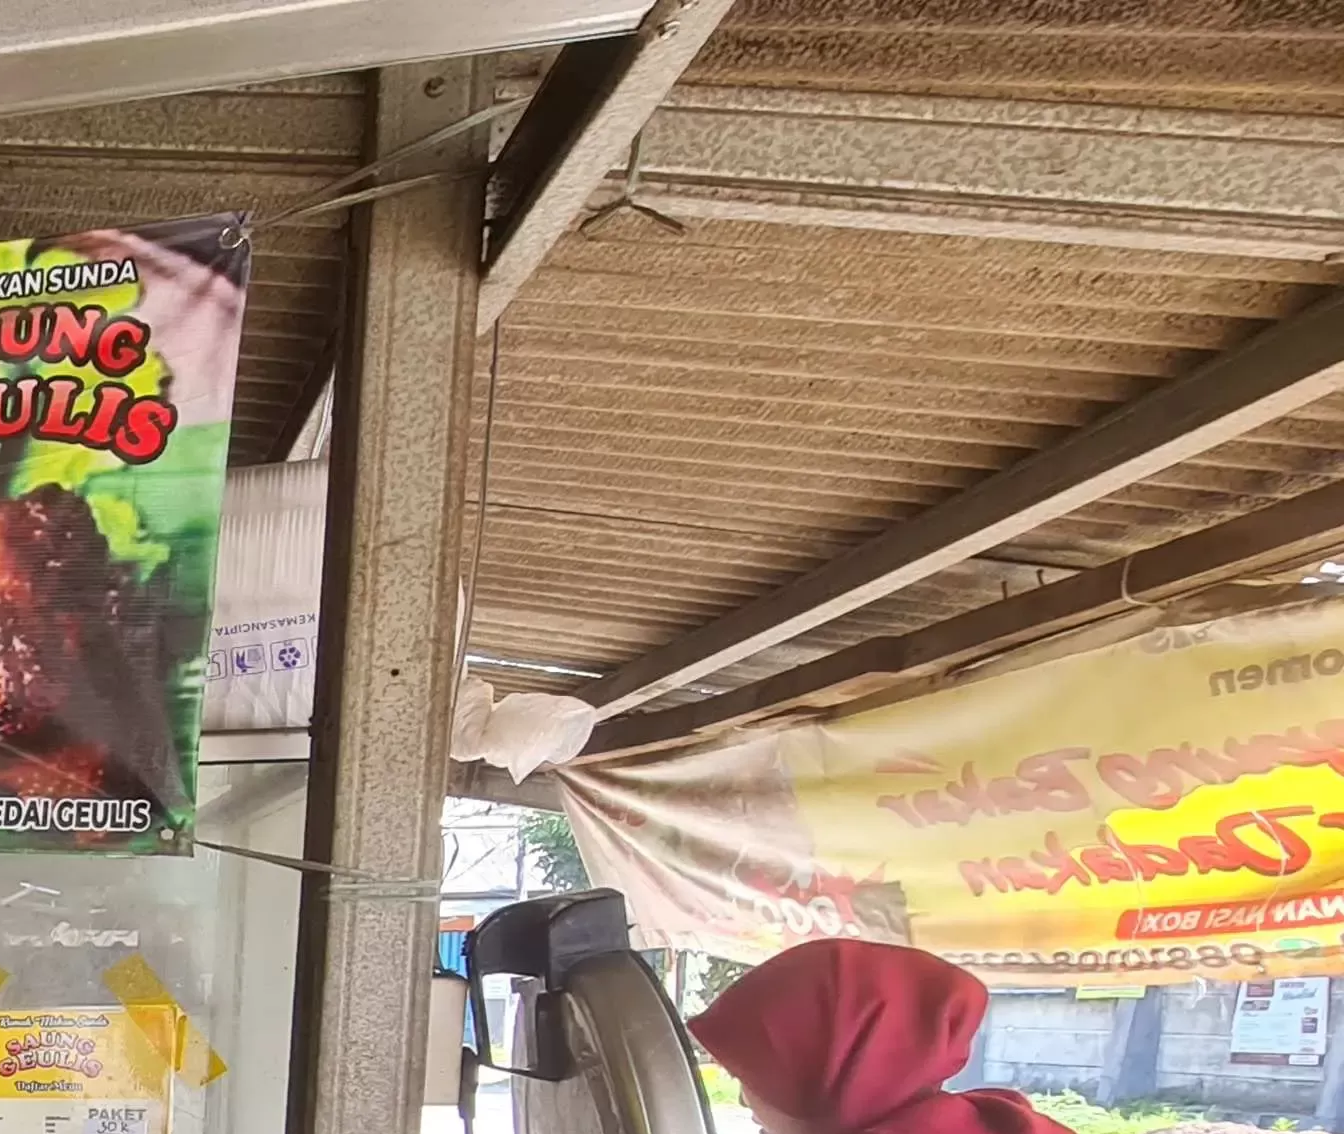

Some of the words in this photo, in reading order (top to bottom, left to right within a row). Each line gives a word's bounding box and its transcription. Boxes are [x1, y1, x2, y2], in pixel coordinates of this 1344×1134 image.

[47, 258, 138, 292] SUNDA
[215, 613, 316, 637] KEMASANCIPTA
[56, 798, 153, 833] GEULIS
[6, 1030, 96, 1055] SAUNG
[88, 1108, 147, 1120] PAKET
